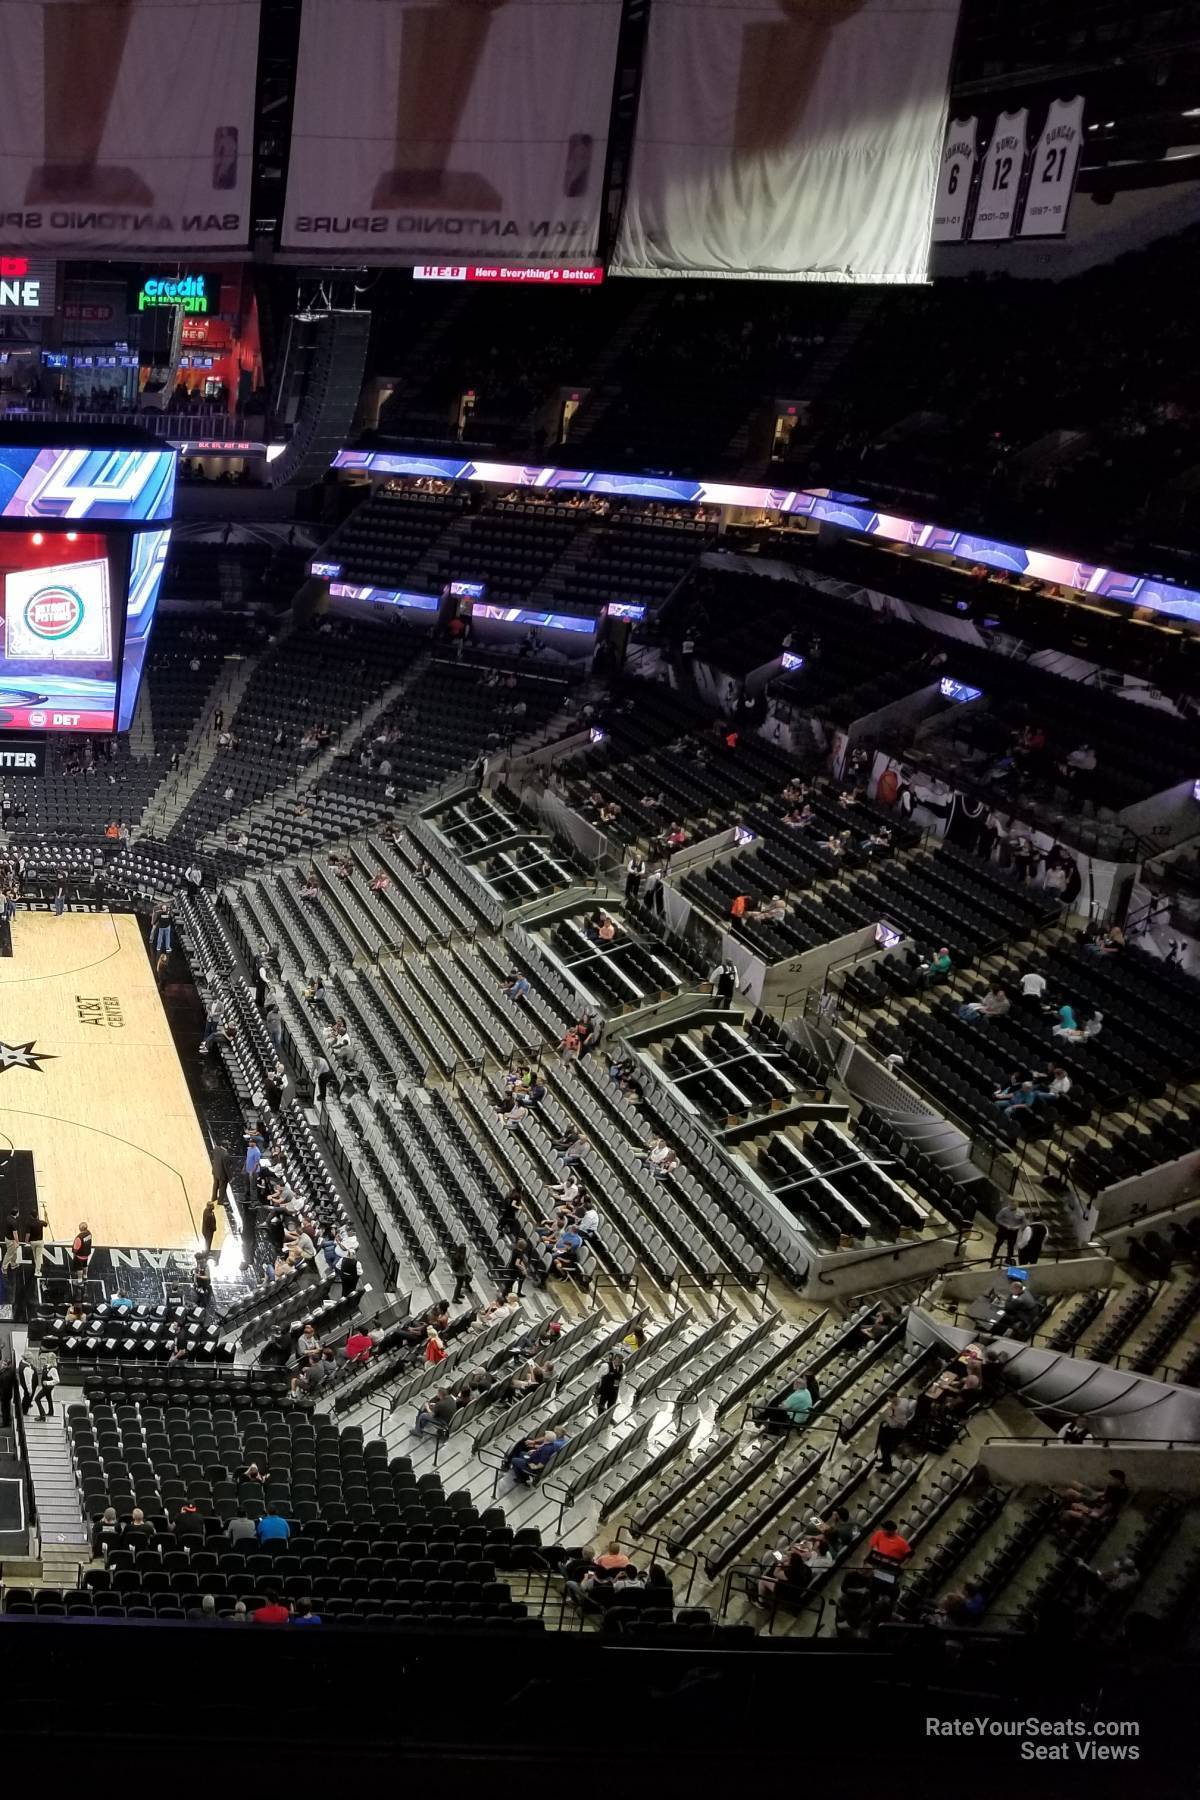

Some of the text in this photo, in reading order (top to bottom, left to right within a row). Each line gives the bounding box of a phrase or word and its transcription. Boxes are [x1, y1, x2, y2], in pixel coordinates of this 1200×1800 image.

[1046, 125, 1077, 145] DUNCAN
[992, 157, 1012, 190] 12
[1042, 147, 1067, 183] 21
[948, 163, 960, 195] 6
[475, 268, 498, 278] Here
[500, 268, 559, 280] Everything's
[144, 274, 205, 297] credit
[180, 443, 189, 454] 7
[52, 714, 81, 726] DET
[789, 963, 802, 973] 22
[76, 995, 106, 1027] AT&T
[103, 996, 125, 1028] CENTER
[109, 1247, 198, 1269] SAN
